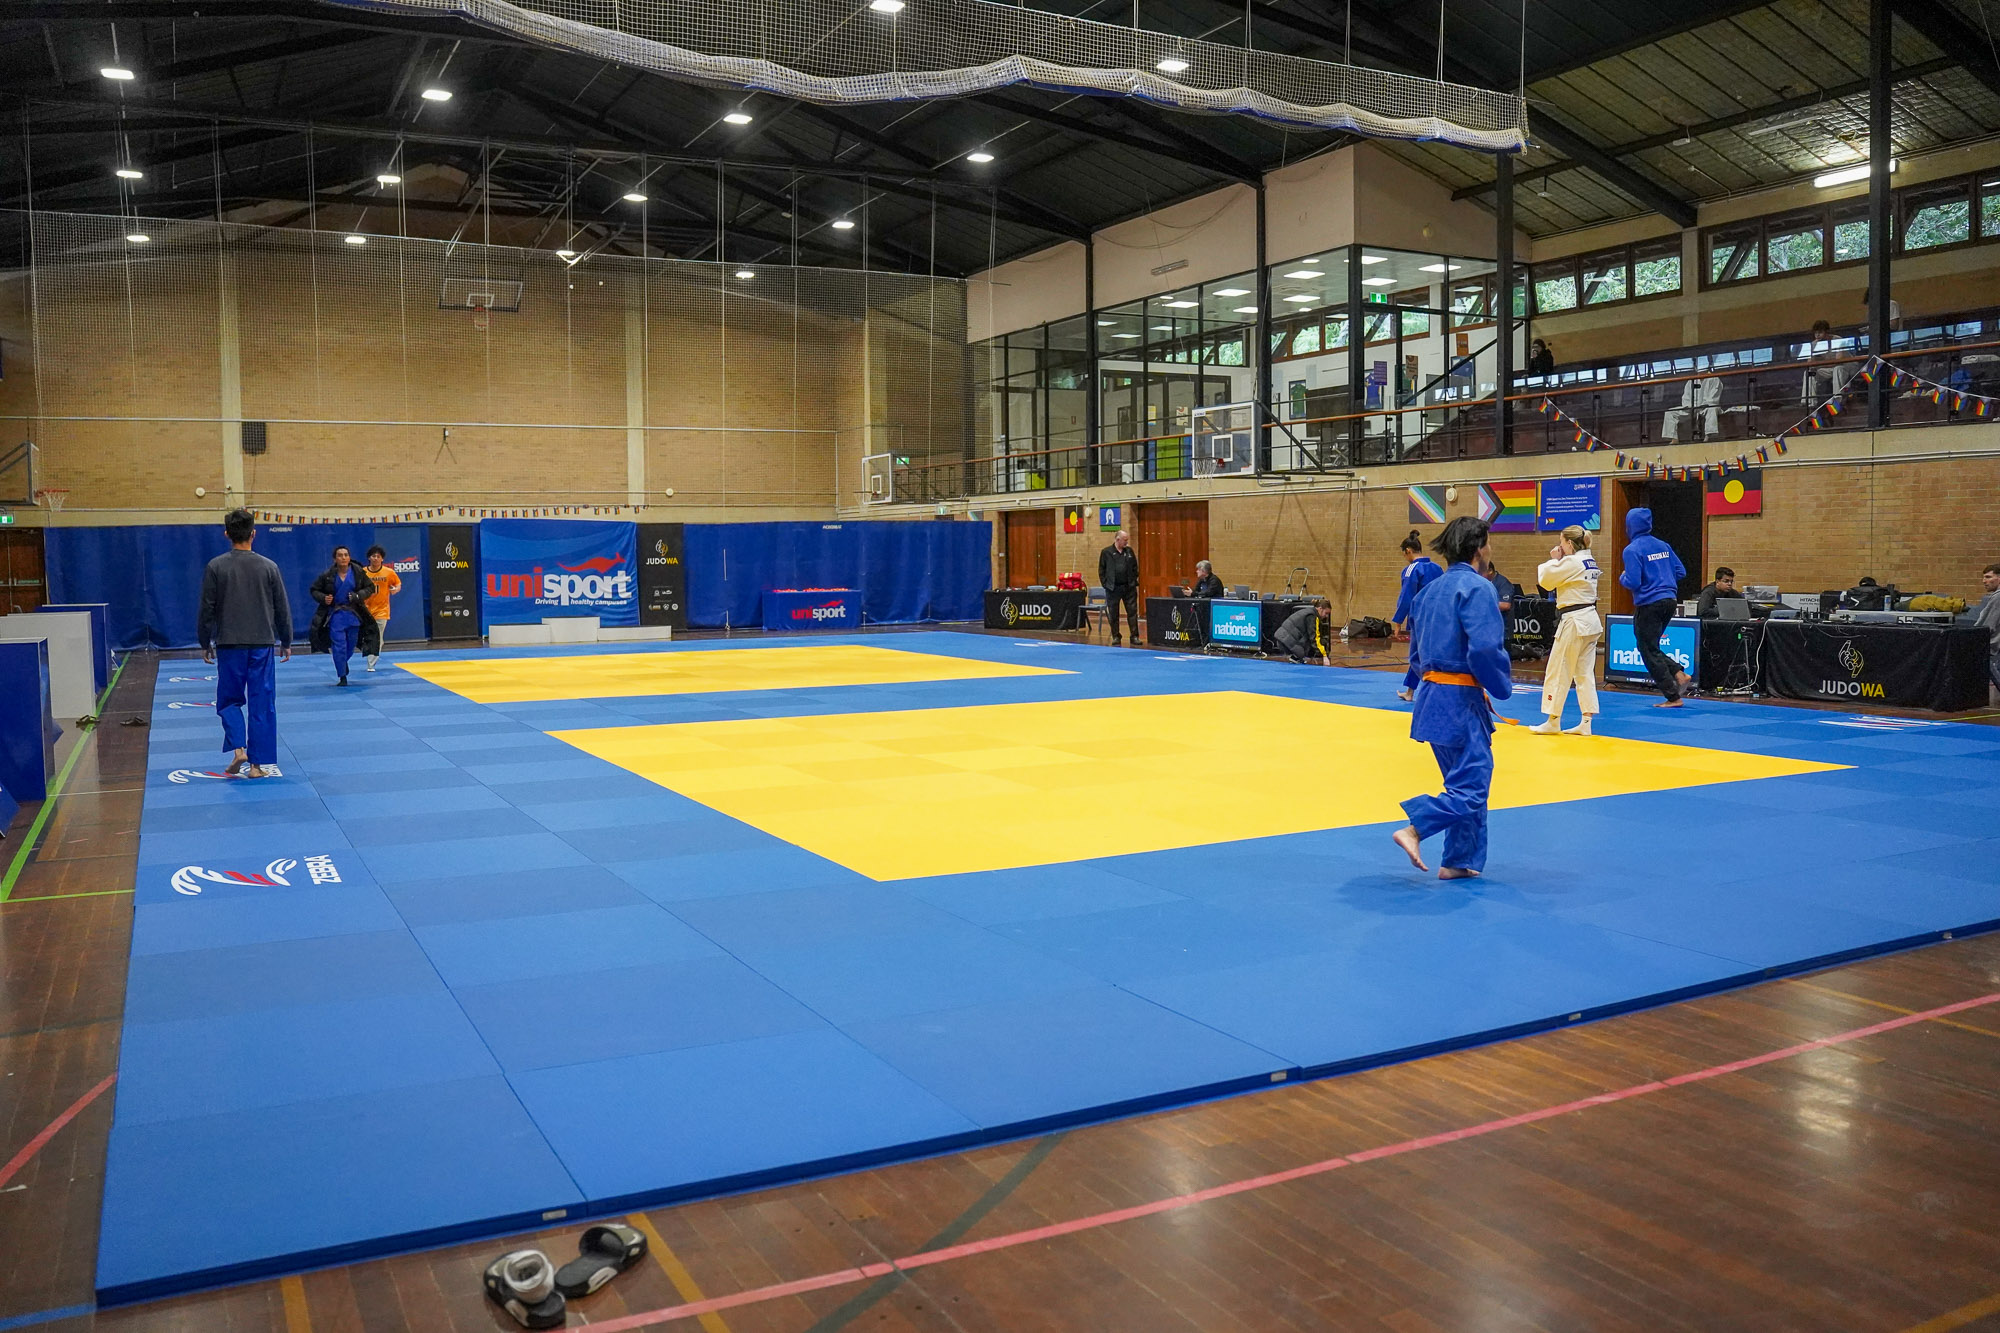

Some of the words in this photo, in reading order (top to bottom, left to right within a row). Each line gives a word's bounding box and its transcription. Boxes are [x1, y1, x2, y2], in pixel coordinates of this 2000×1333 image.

[436, 561, 469, 569] JUDOWA
[646, 557, 679, 565] JUDOWA
[486, 566, 633, 606] unisport
[535, 598, 559, 606] Driving
[791, 605, 847, 622] unisport
[1019, 604, 1052, 616] JUDO
[1165, 631, 1190, 641] JUDOWA
[1214, 622, 1257, 637] nationals
[1818, 680, 1885, 697] JUDOWA
[304, 854, 343, 885] ZEBRA
